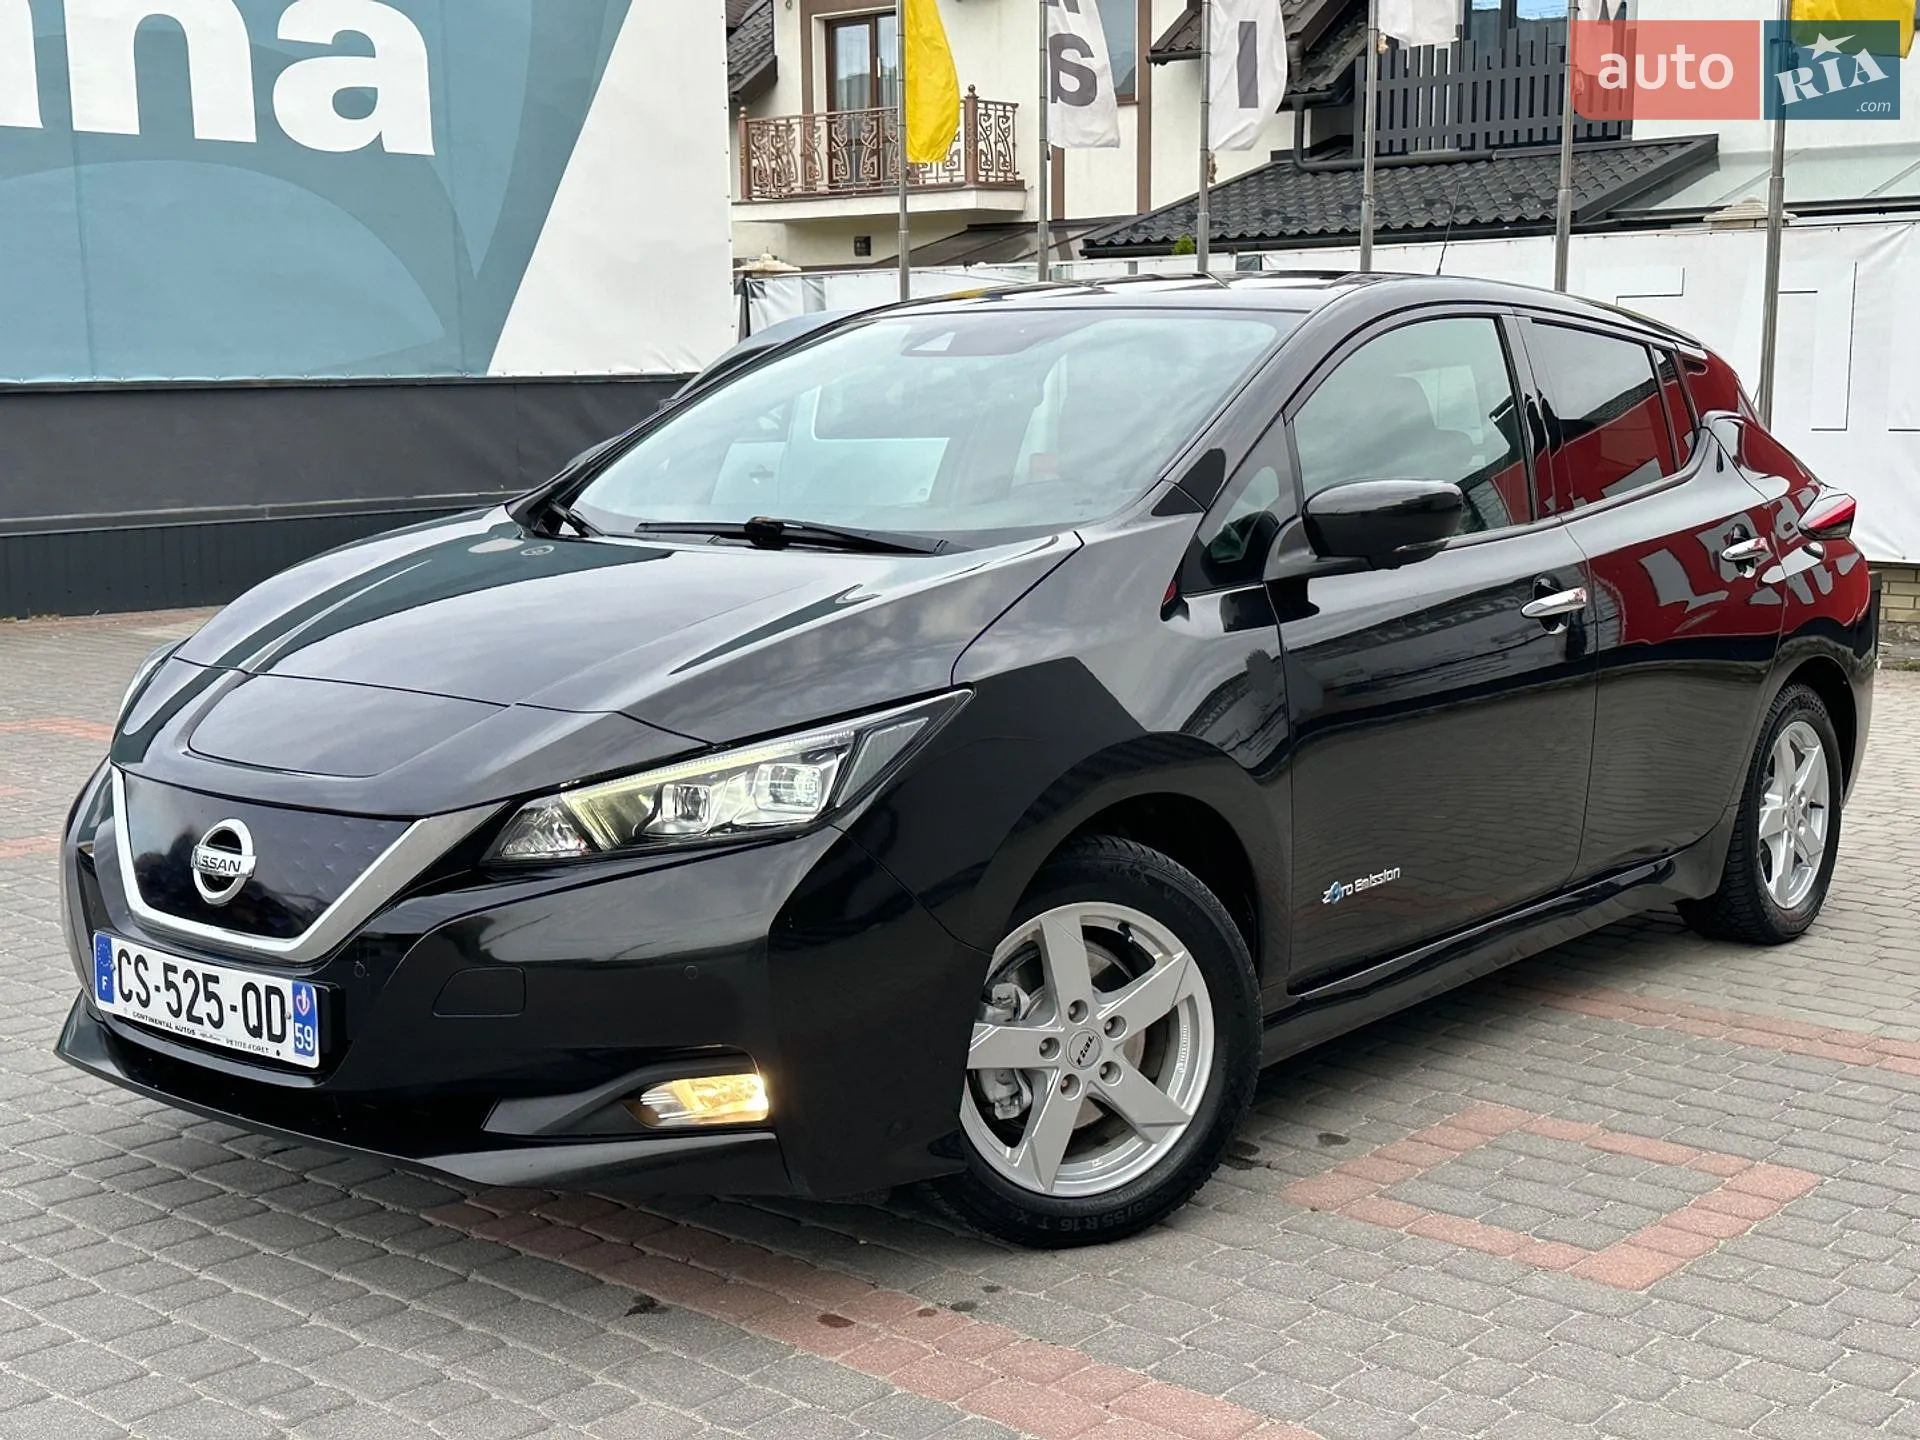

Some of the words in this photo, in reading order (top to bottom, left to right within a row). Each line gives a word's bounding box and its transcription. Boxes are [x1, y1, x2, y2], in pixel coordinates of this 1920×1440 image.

[101, 975, 108, 991] F
[117, 948, 287, 1044] CS-525-QD
[132, 1011, 173, 1030] CONTINENTAL
[294, 1022, 313, 1051] 59
